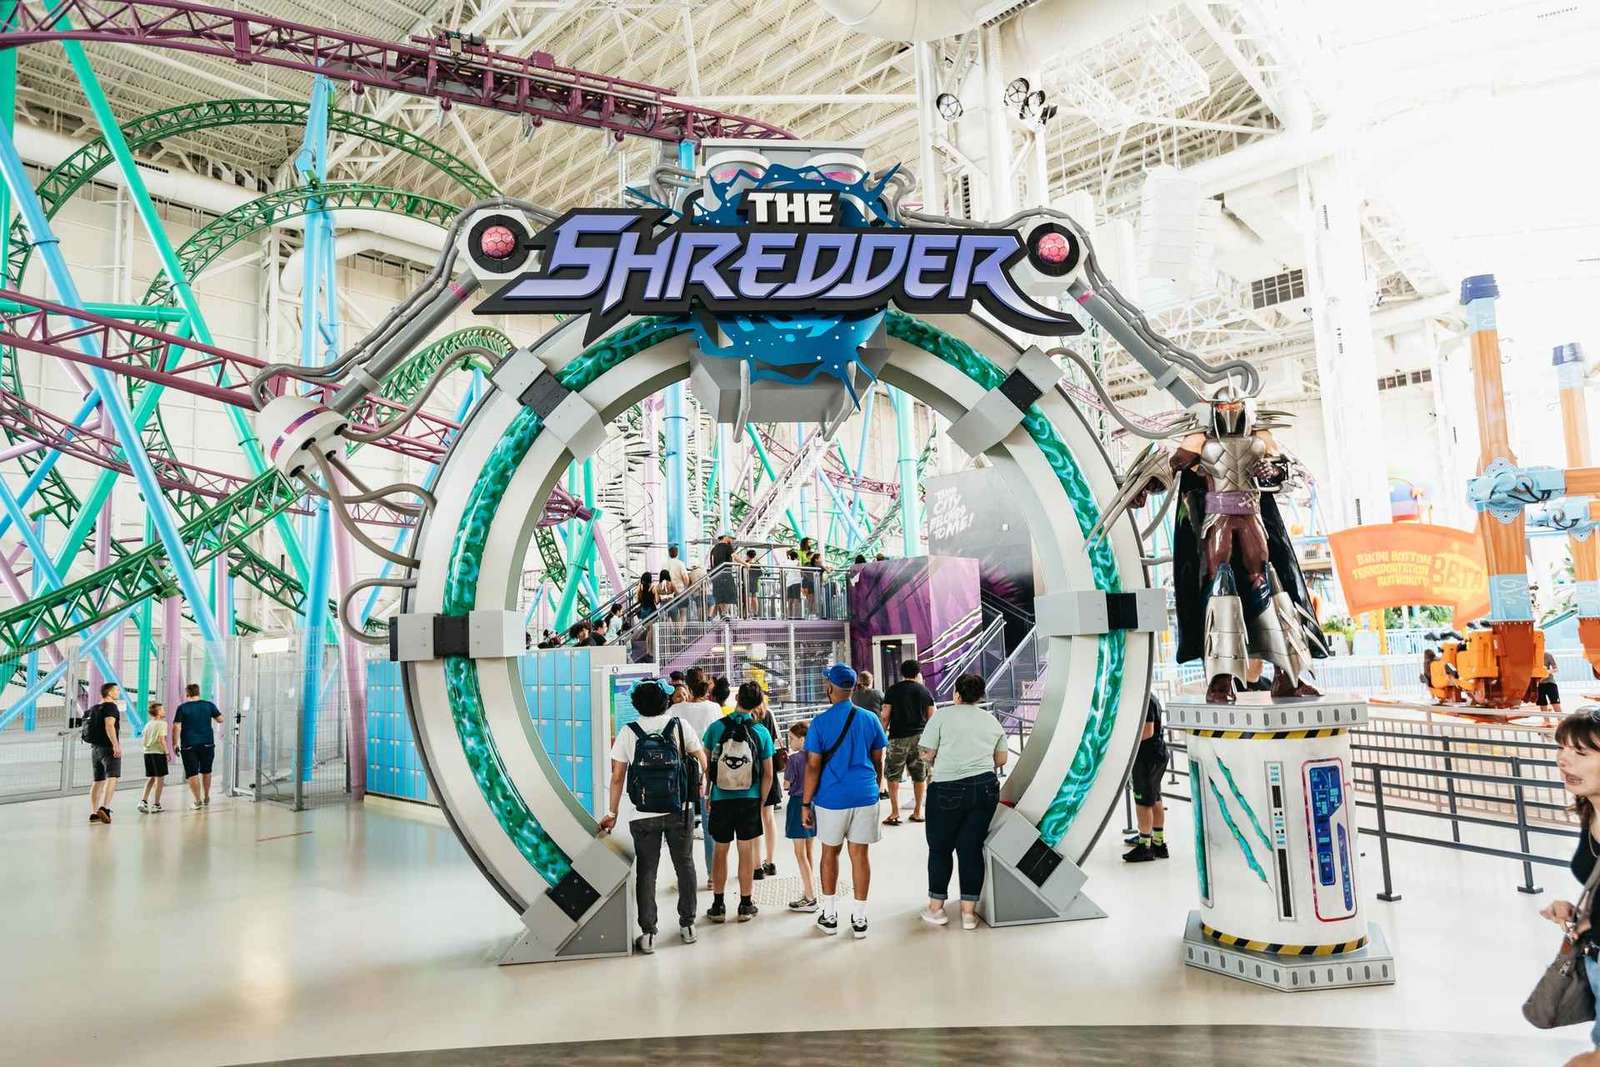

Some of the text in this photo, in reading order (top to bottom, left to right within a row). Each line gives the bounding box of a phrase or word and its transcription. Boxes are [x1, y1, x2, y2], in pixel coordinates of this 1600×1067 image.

[747, 192, 834, 223] THE
[503, 213, 1075, 323] SHREDDER
[933, 494, 962, 515] CITY
[1355, 550, 1432, 566] BIKINI BOTTOM
